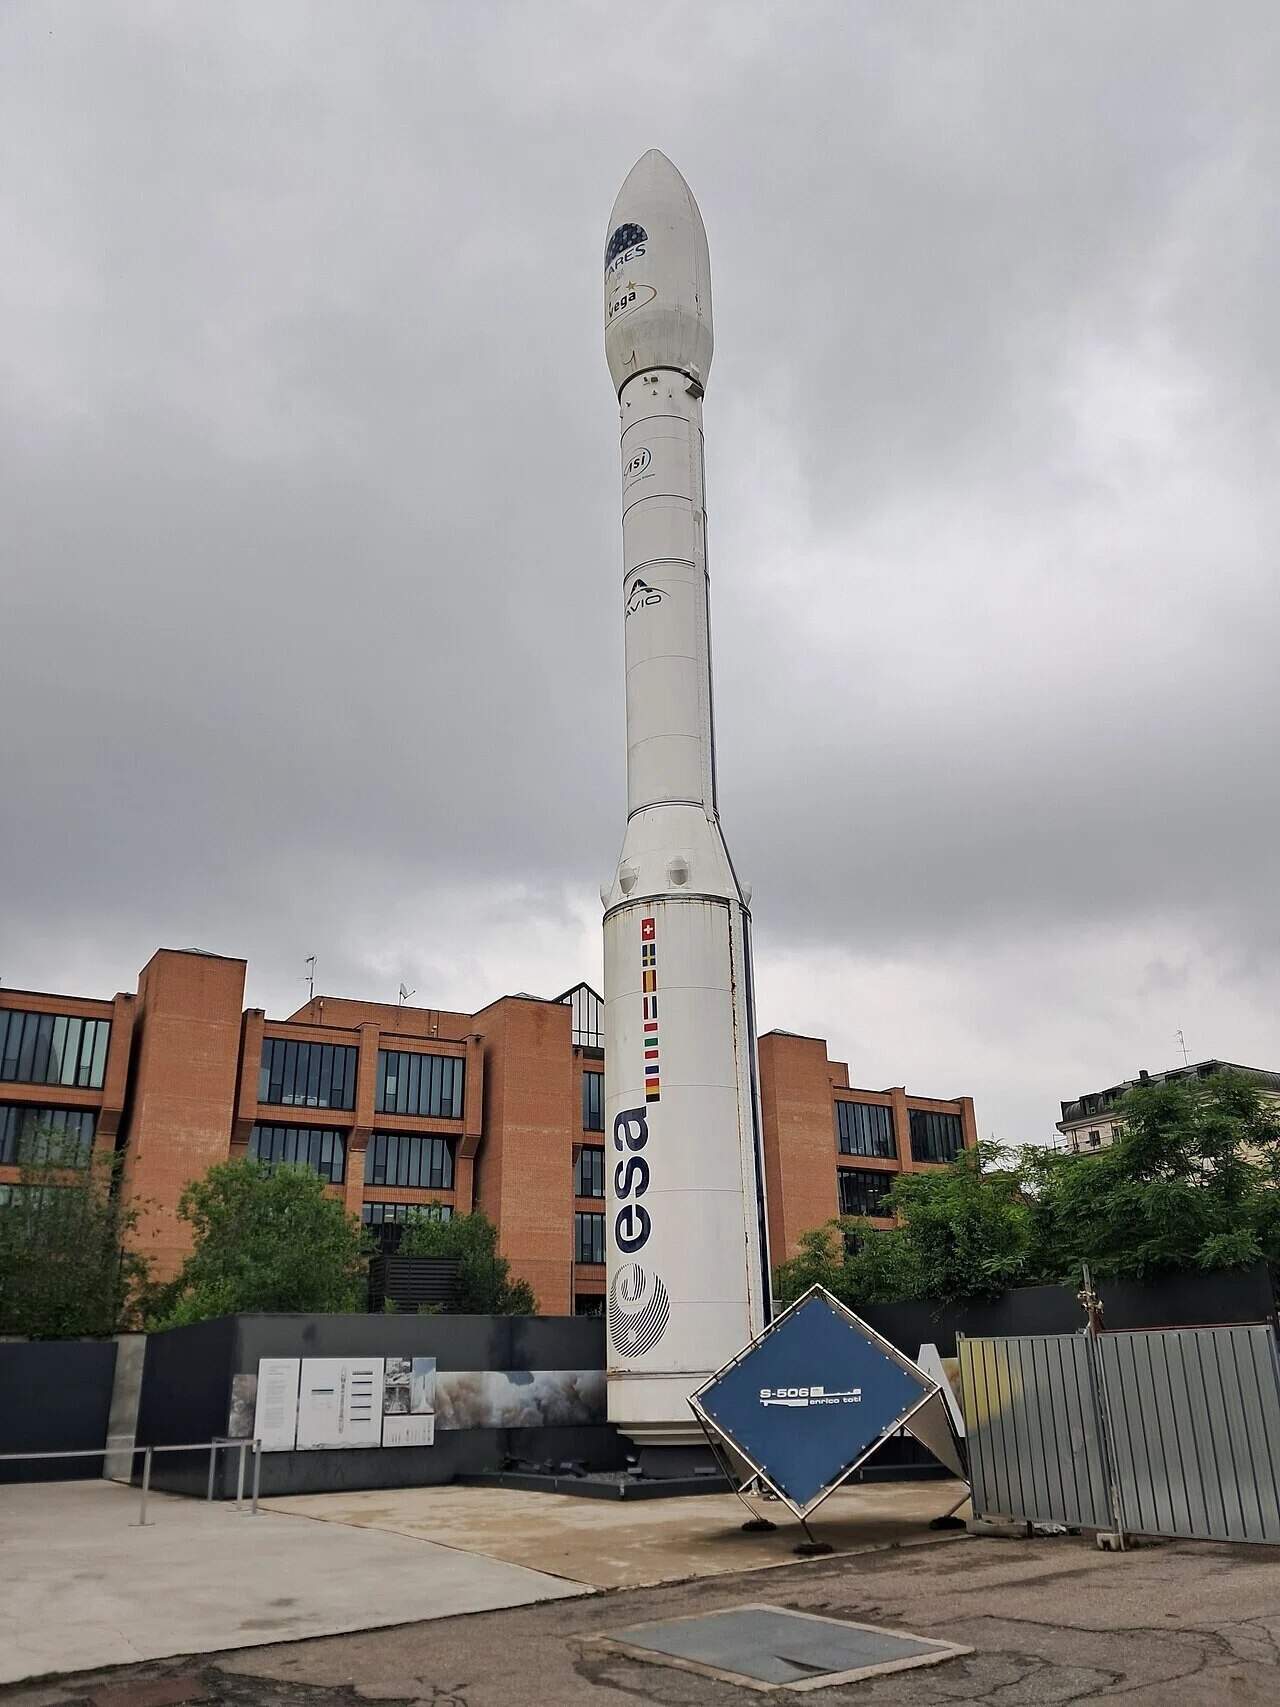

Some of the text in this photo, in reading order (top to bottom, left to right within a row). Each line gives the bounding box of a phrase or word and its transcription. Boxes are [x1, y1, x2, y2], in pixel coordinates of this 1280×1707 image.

[613, 1105, 651, 1254] esa
[760, 1388, 809, 1398] S-506
[809, 1395, 862, 1405] enrico toti
